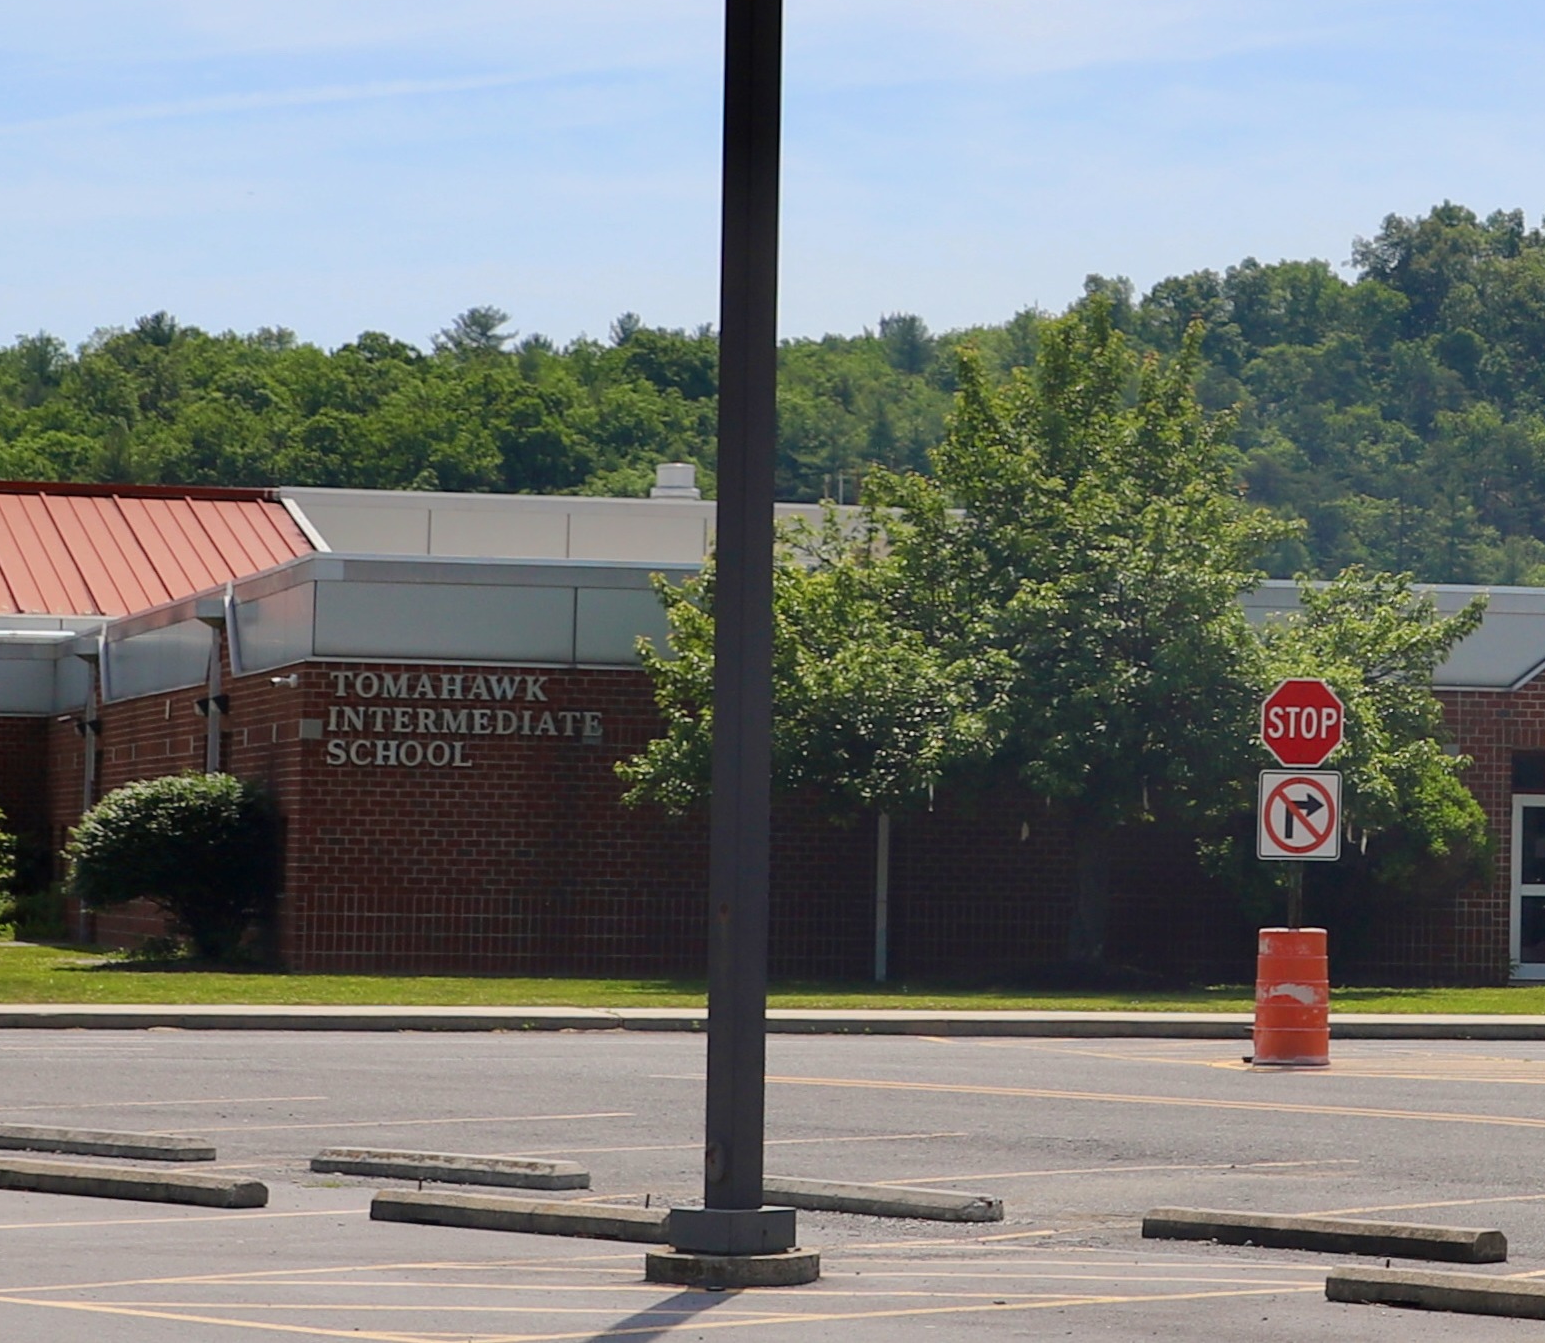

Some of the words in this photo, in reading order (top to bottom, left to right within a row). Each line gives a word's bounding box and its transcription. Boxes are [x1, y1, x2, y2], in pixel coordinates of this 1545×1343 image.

[329, 671, 549, 702] TOMAHAWK
[327, 705, 604, 737] INTERMEDIATE
[1267, 706, 1338, 740] STOP
[326, 739, 473, 767] SCHOOL
